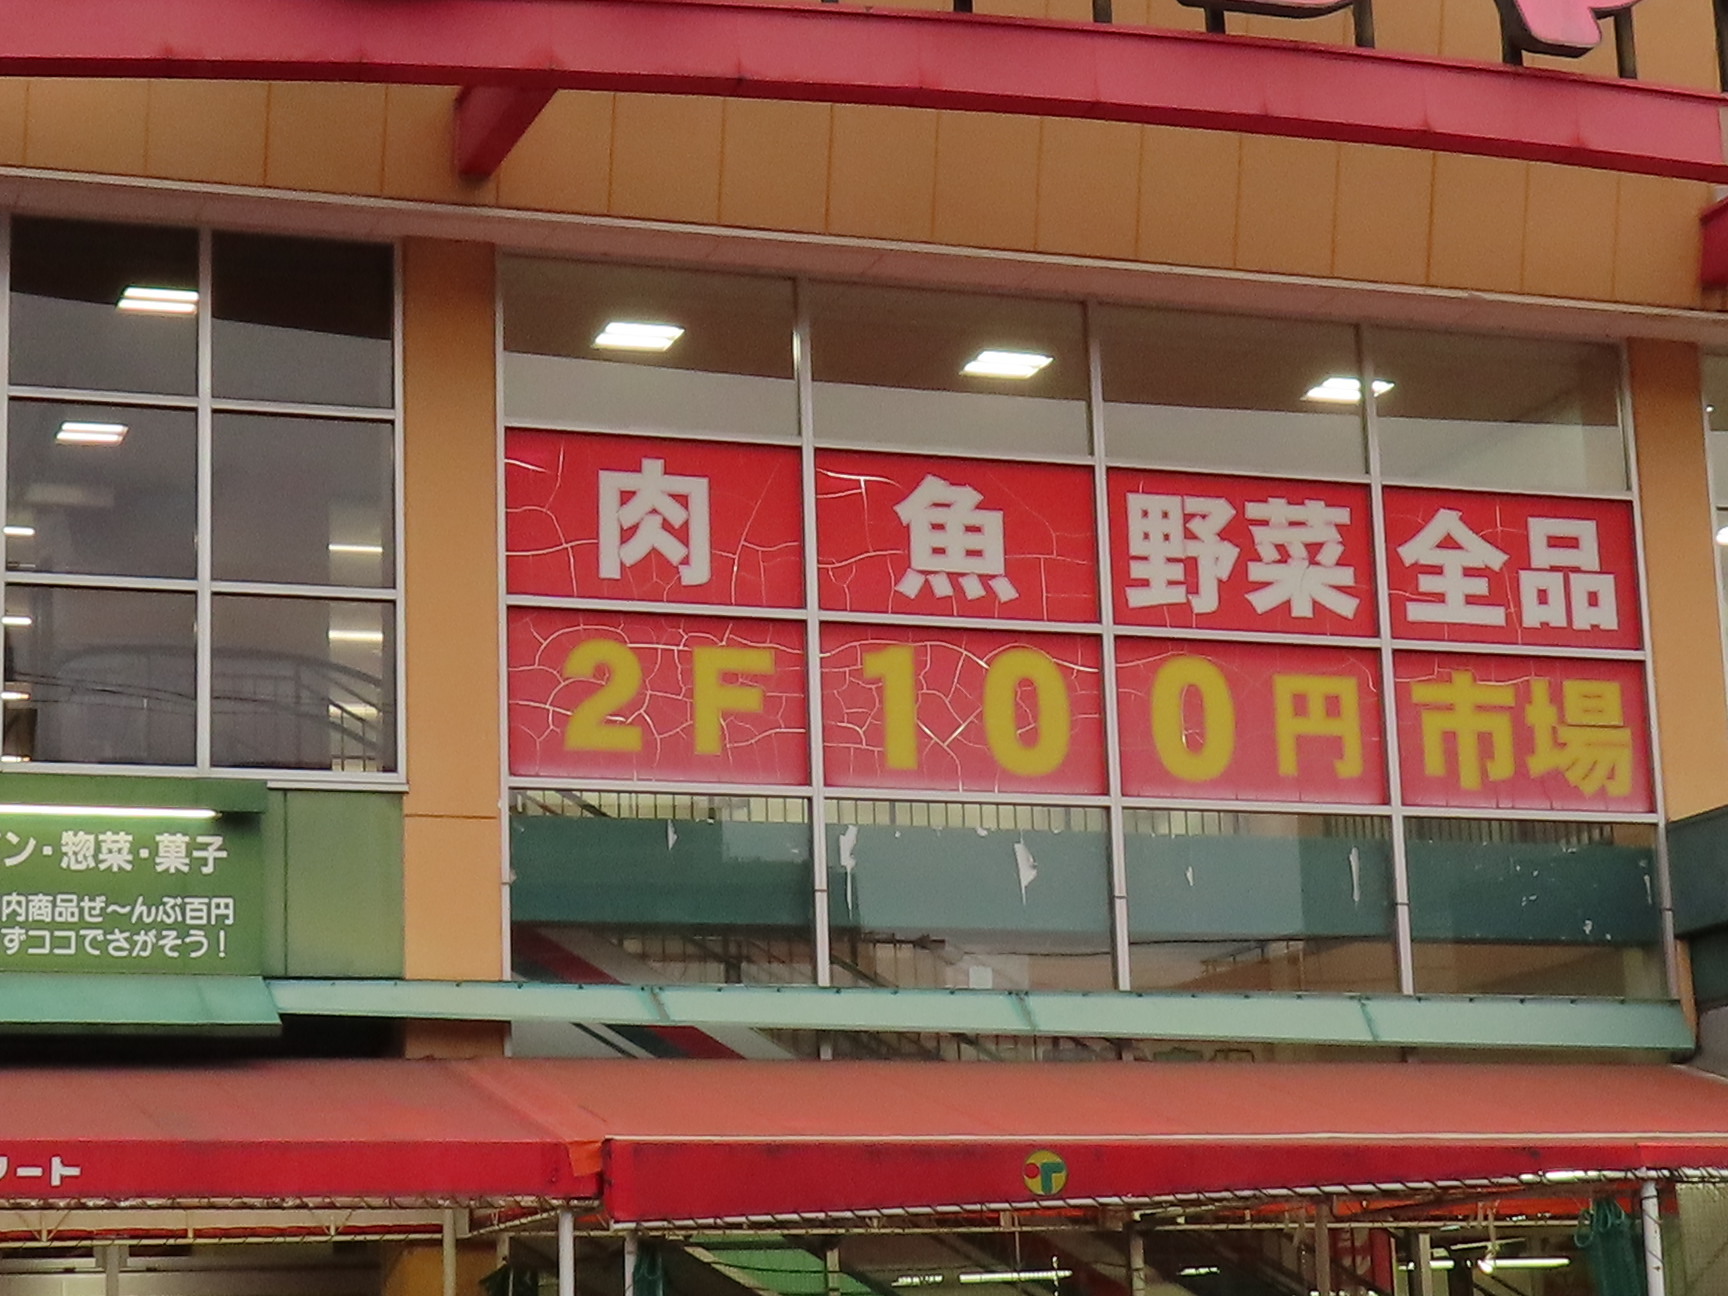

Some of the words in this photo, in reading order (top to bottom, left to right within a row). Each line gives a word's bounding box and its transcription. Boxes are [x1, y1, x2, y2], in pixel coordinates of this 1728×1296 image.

[597, 457, 711, 588] 肉
[894, 473, 1020, 604] 魚
[1123, 489, 1359, 621] 野菜
[1397, 508, 1620, 631] 全品
